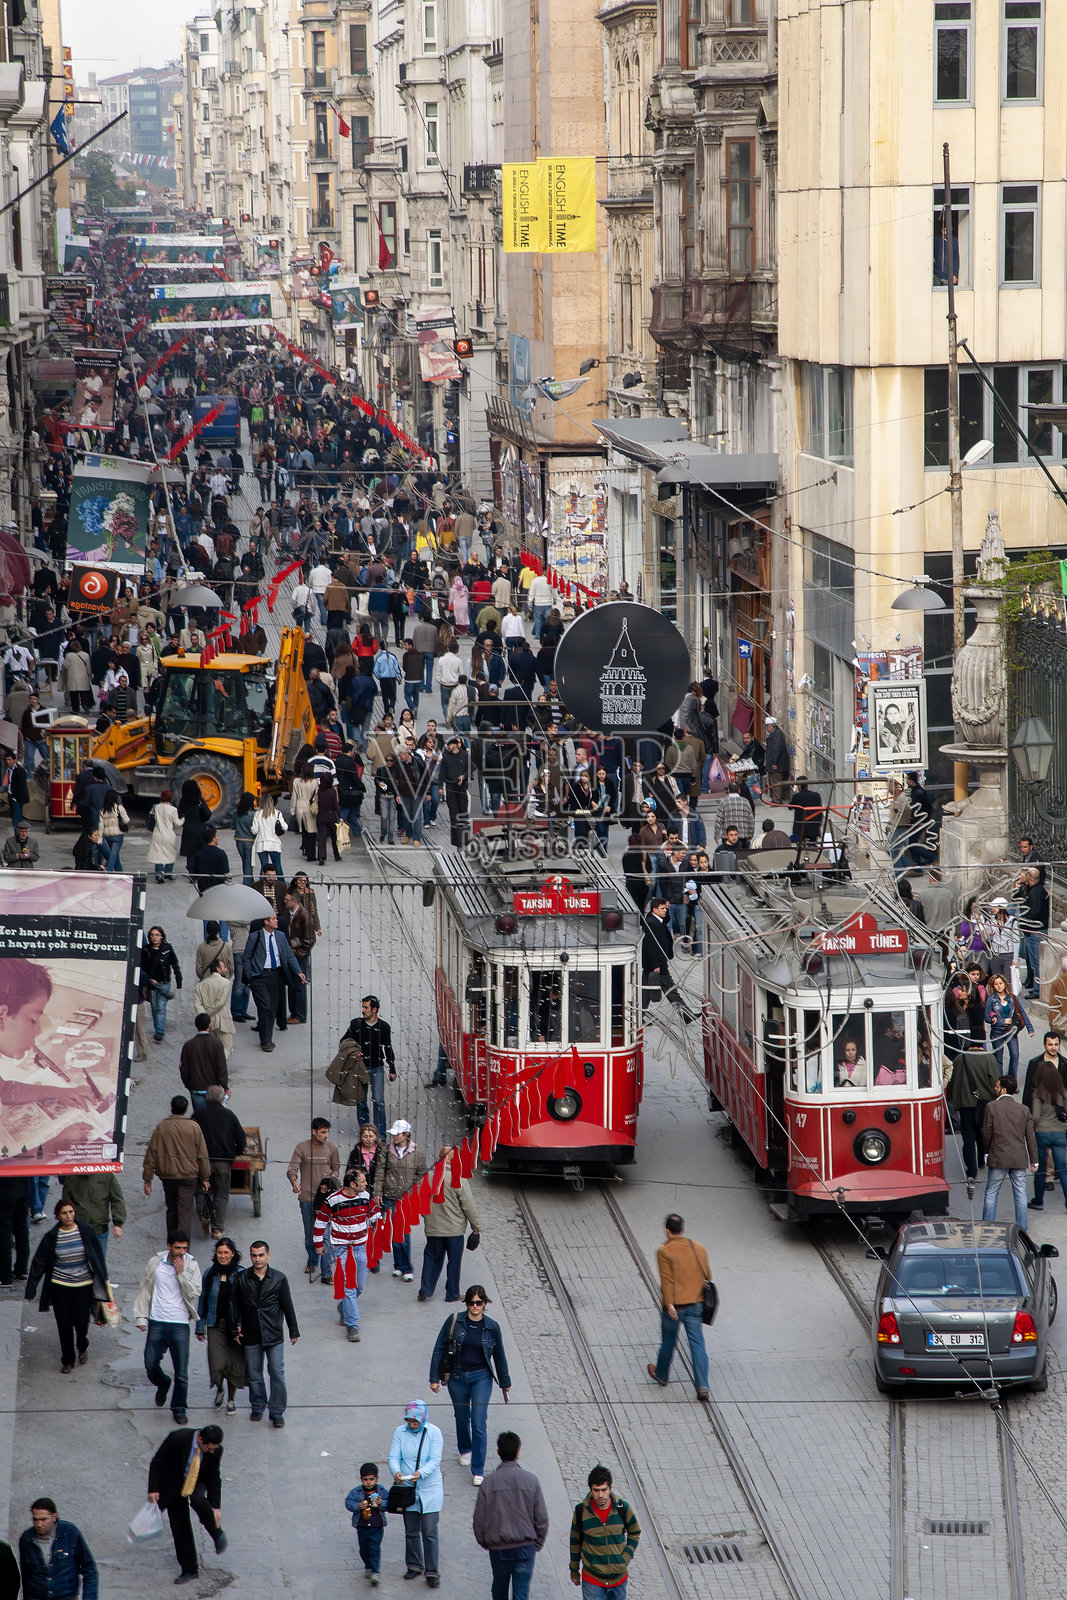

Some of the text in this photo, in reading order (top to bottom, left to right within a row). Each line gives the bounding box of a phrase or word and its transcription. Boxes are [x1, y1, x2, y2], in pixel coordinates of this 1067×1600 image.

[519, 169, 530, 248] ENGLISH TIME
[555, 164, 567, 248] ENGLISH TIME
[521, 896, 591, 909] TAKSİM TÜNEL
[19, 927, 53, 938] hayat
[55, 928, 71, 938] bir
[73, 930, 97, 940] film
[8, 939, 46, 950] hayatı
[48, 940, 68, 951] çok
[70, 942, 127, 952] seviyoruz
[869, 933, 902, 949] TÜNEL
[795, 1113, 807, 1128] 47
[72, 1165, 117, 1173] AKBANK
[933, 1335, 944, 1345] 34
[969, 1335, 983, 1345] 312
